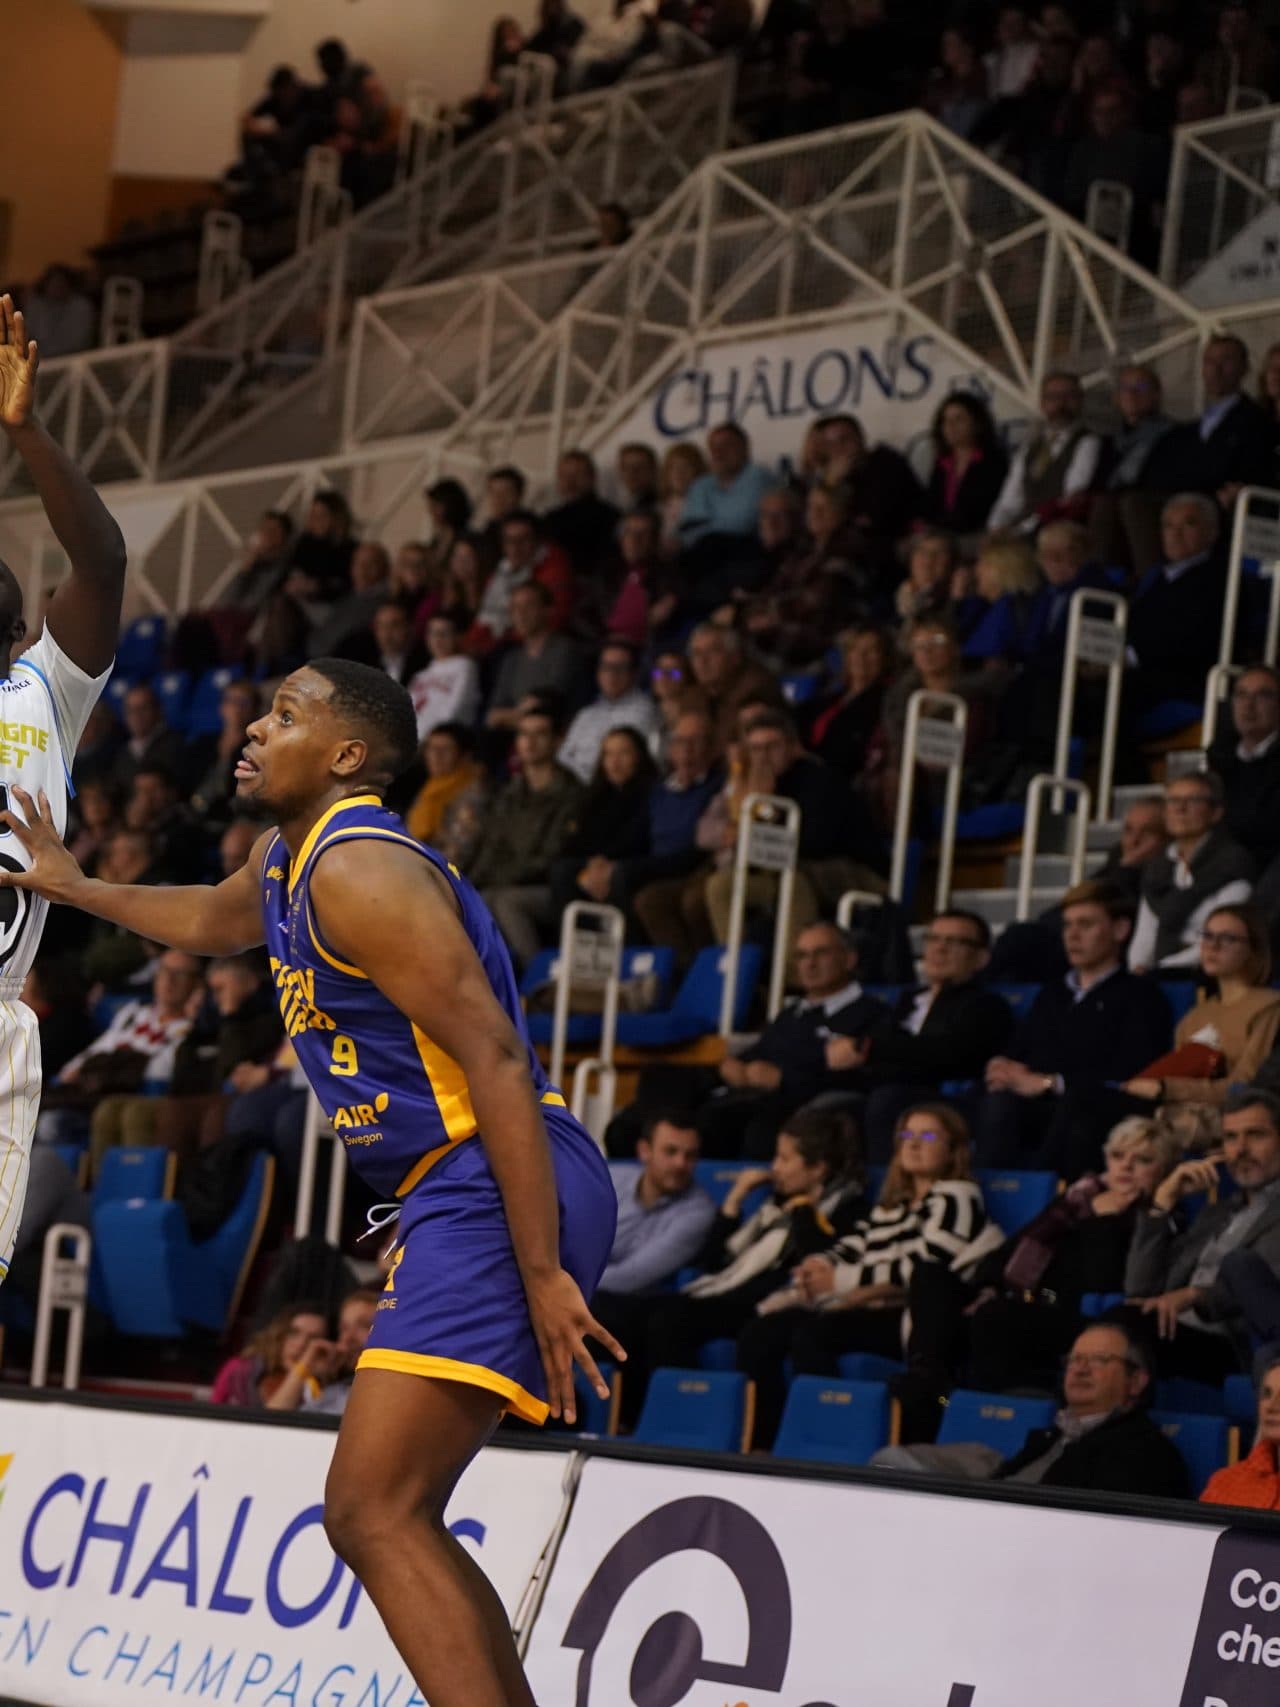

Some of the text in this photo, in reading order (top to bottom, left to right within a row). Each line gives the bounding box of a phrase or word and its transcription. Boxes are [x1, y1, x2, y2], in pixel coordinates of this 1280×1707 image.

[653, 333, 935, 438] CHÂLONS
[329, 1034, 359, 1077] 9
[344, 1131, 384, 1146] Swegon
[21, 1463, 487, 1630] CHÂLO
